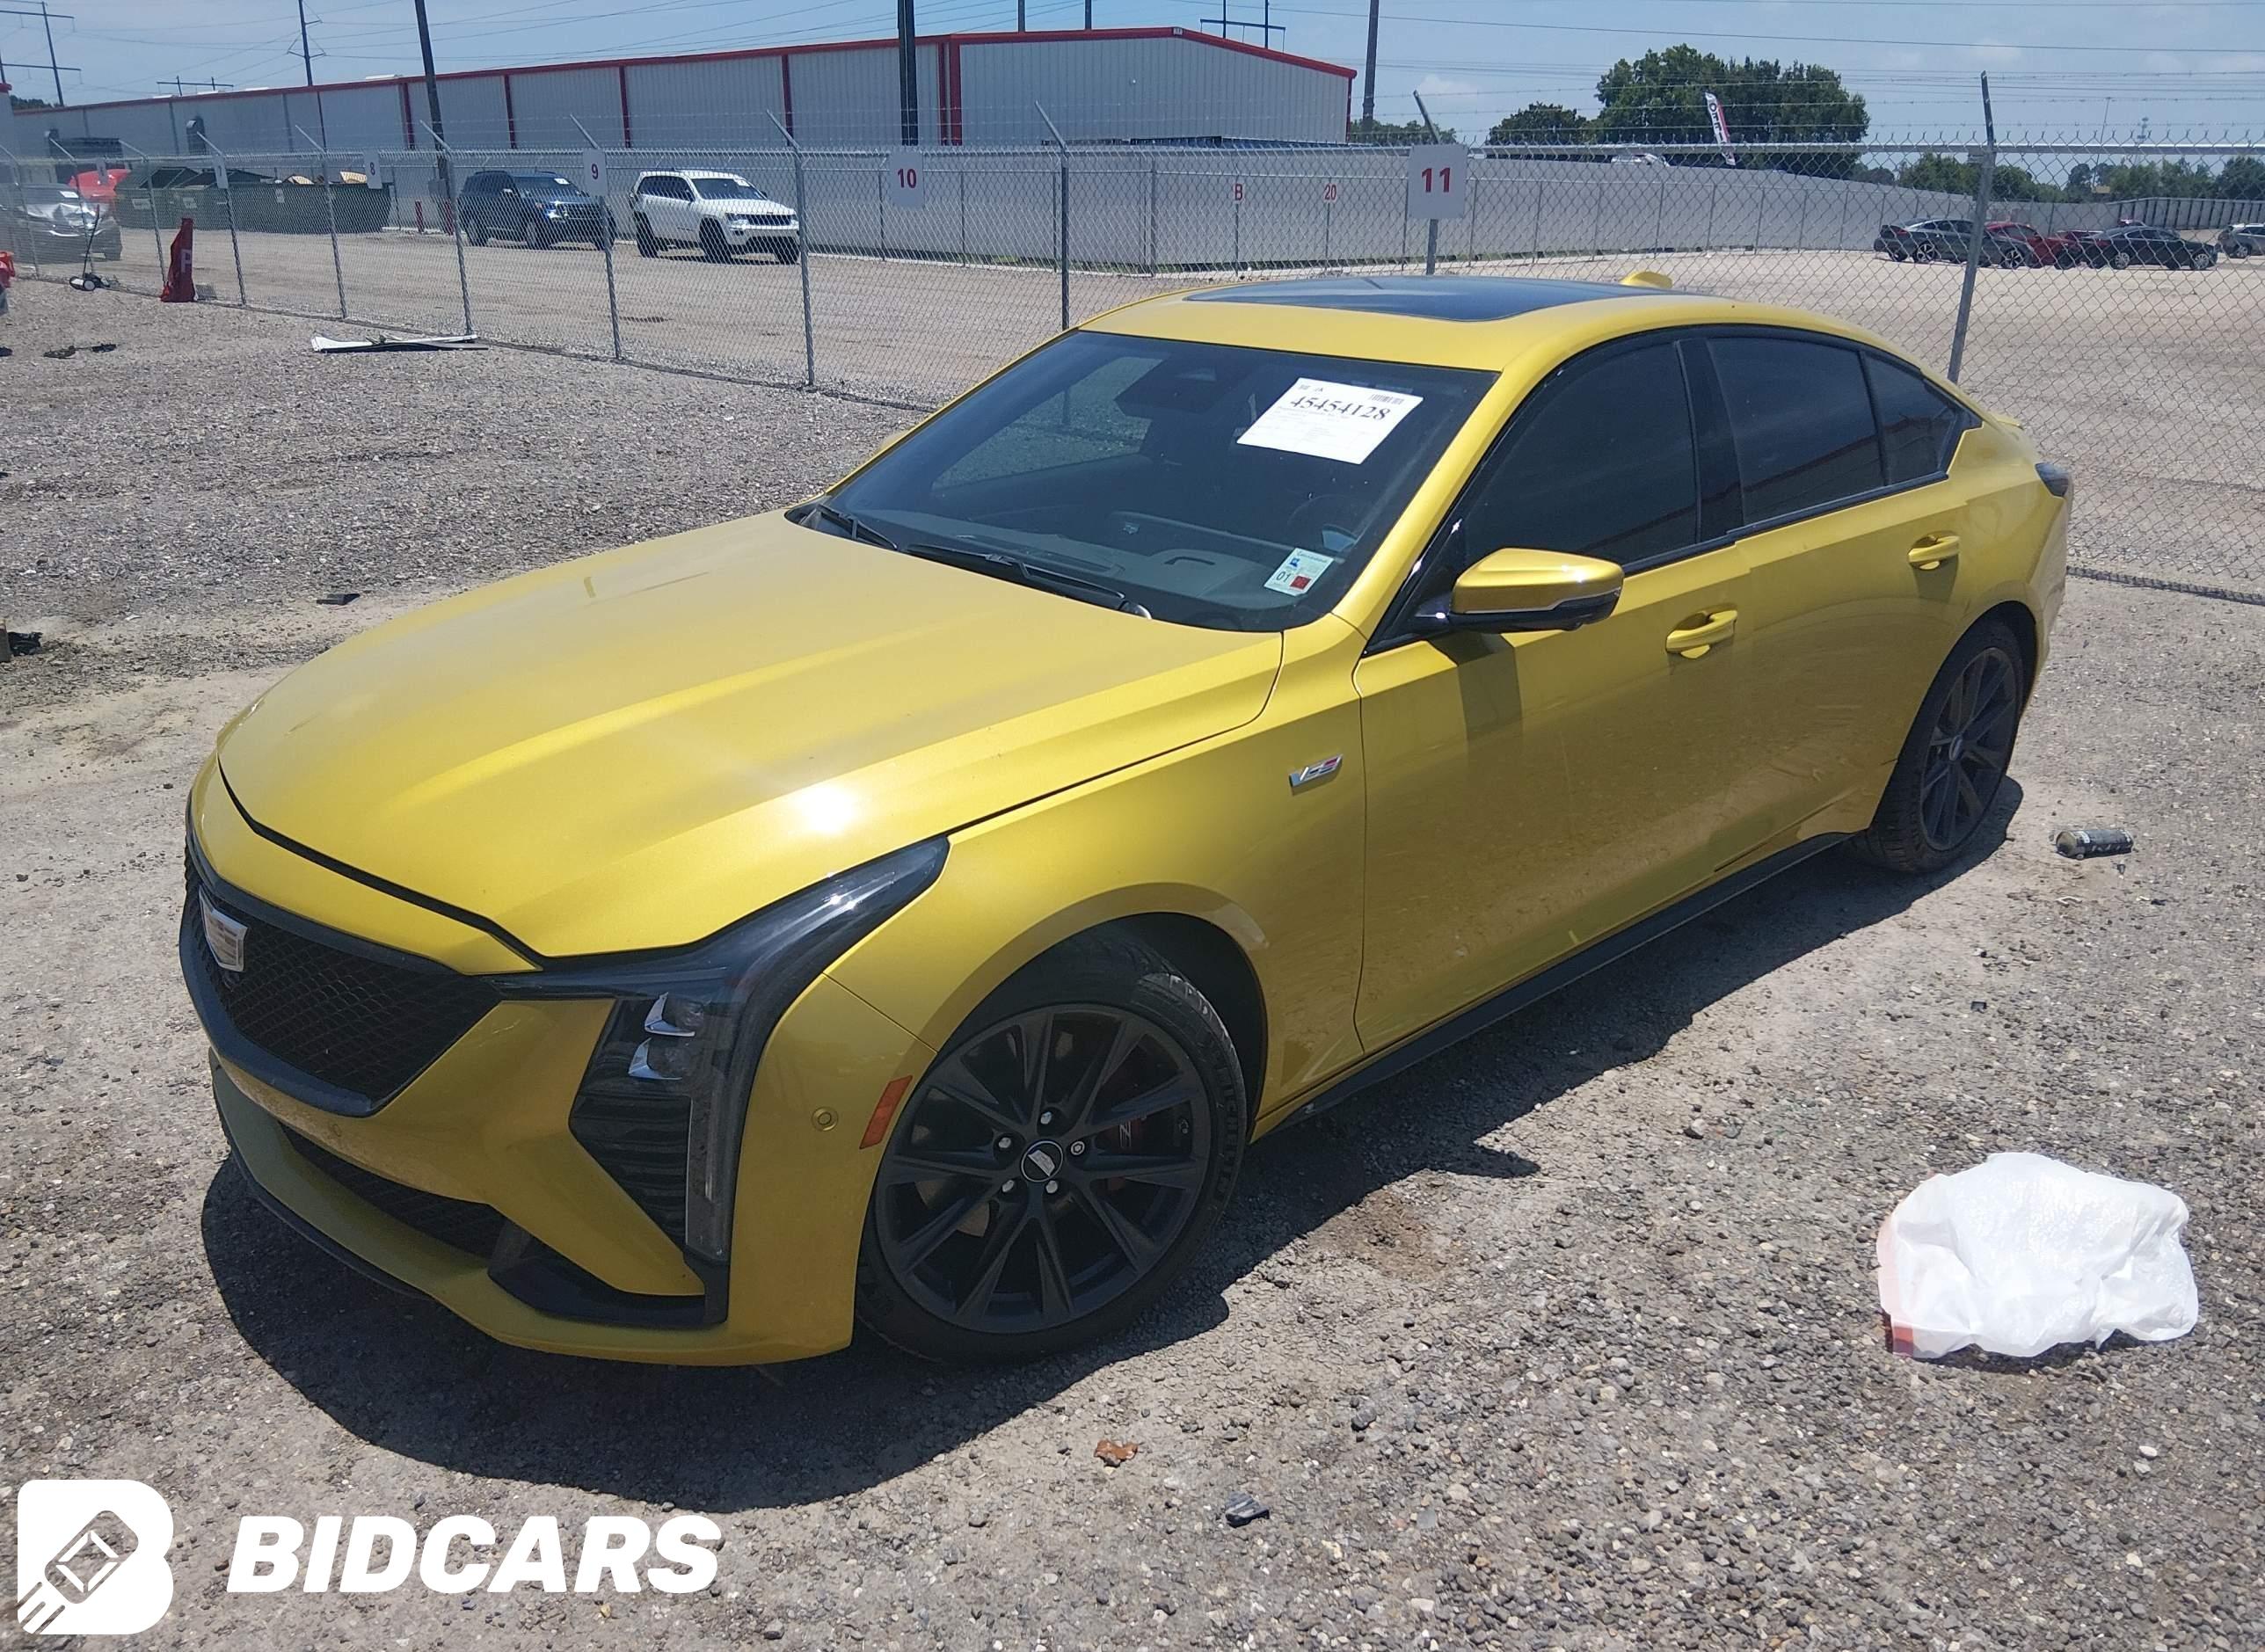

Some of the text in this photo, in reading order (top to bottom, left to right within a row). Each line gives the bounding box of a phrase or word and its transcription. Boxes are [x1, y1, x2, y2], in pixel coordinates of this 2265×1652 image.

[369, 162, 375, 176] 8
[591, 164, 599, 180] 9
[897, 168, 917, 189] 10
[1421, 167, 1451, 193] 11
[1234, 183, 1243, 201] B
[1324, 184, 1336, 201] 20
[1290, 396, 1391, 420] 45454128
[1276, 571, 1292, 583] 01
